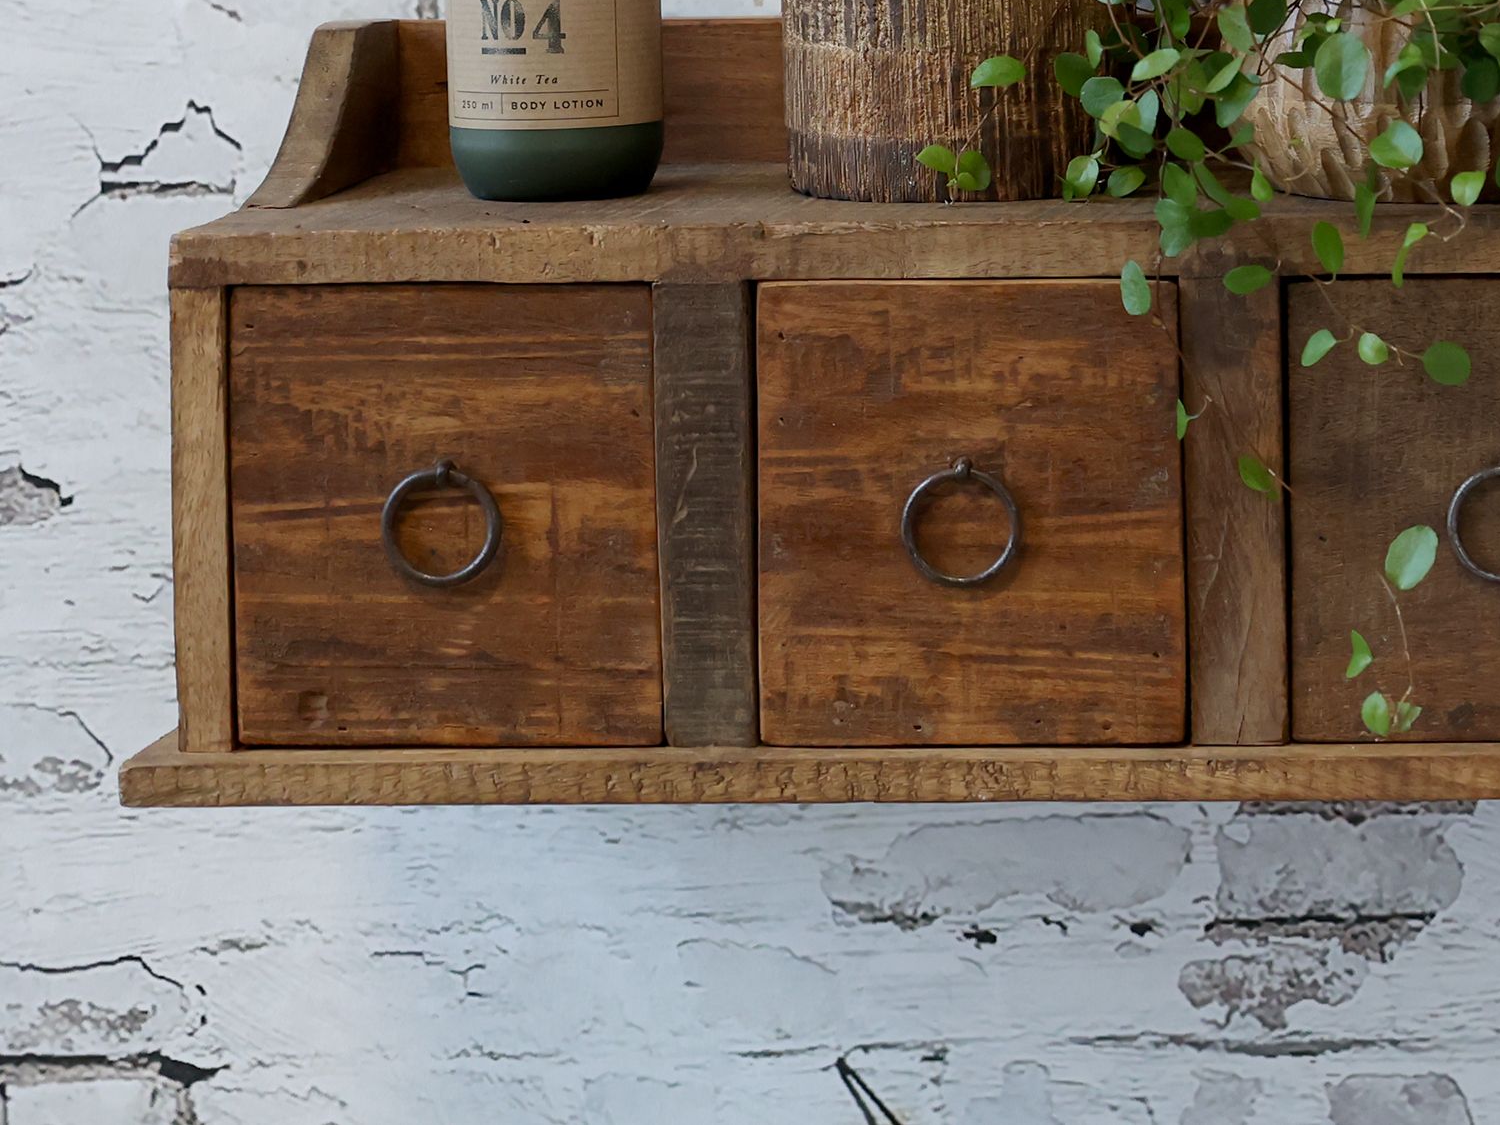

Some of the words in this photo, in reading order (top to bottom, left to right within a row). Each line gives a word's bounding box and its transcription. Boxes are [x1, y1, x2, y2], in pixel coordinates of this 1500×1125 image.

[490, 74, 527, 85] White
[535, 74, 559, 85] Tea
[461, 99, 477, 110] 250
[481, 100, 494, 110] ml
[511, 100, 547, 110] BODY
[553, 99, 604, 110] LOTION
